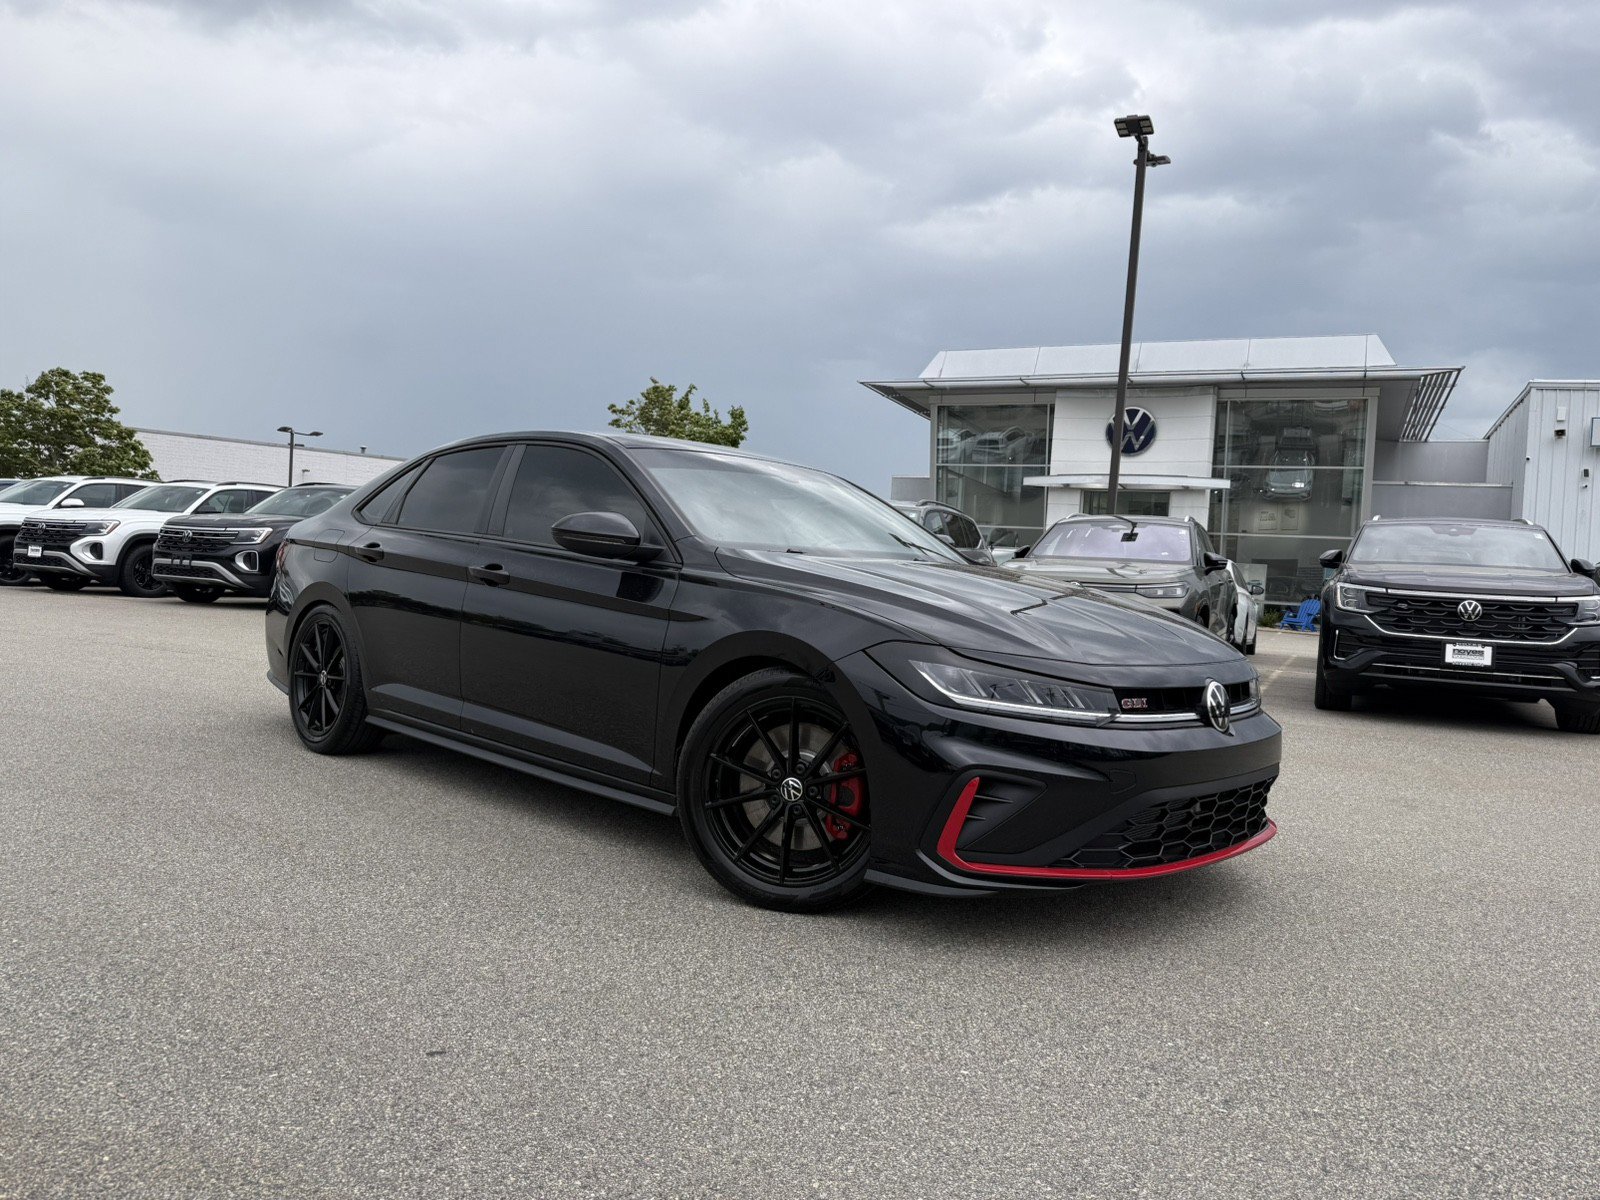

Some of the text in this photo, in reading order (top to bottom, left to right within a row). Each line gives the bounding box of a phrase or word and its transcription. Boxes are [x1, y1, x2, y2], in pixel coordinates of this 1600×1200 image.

[1106, 407, 1156, 455] VW
[1458, 600, 1482, 621] VW
[1207, 681, 1230, 731] VW
[781, 777, 803, 801] VW
